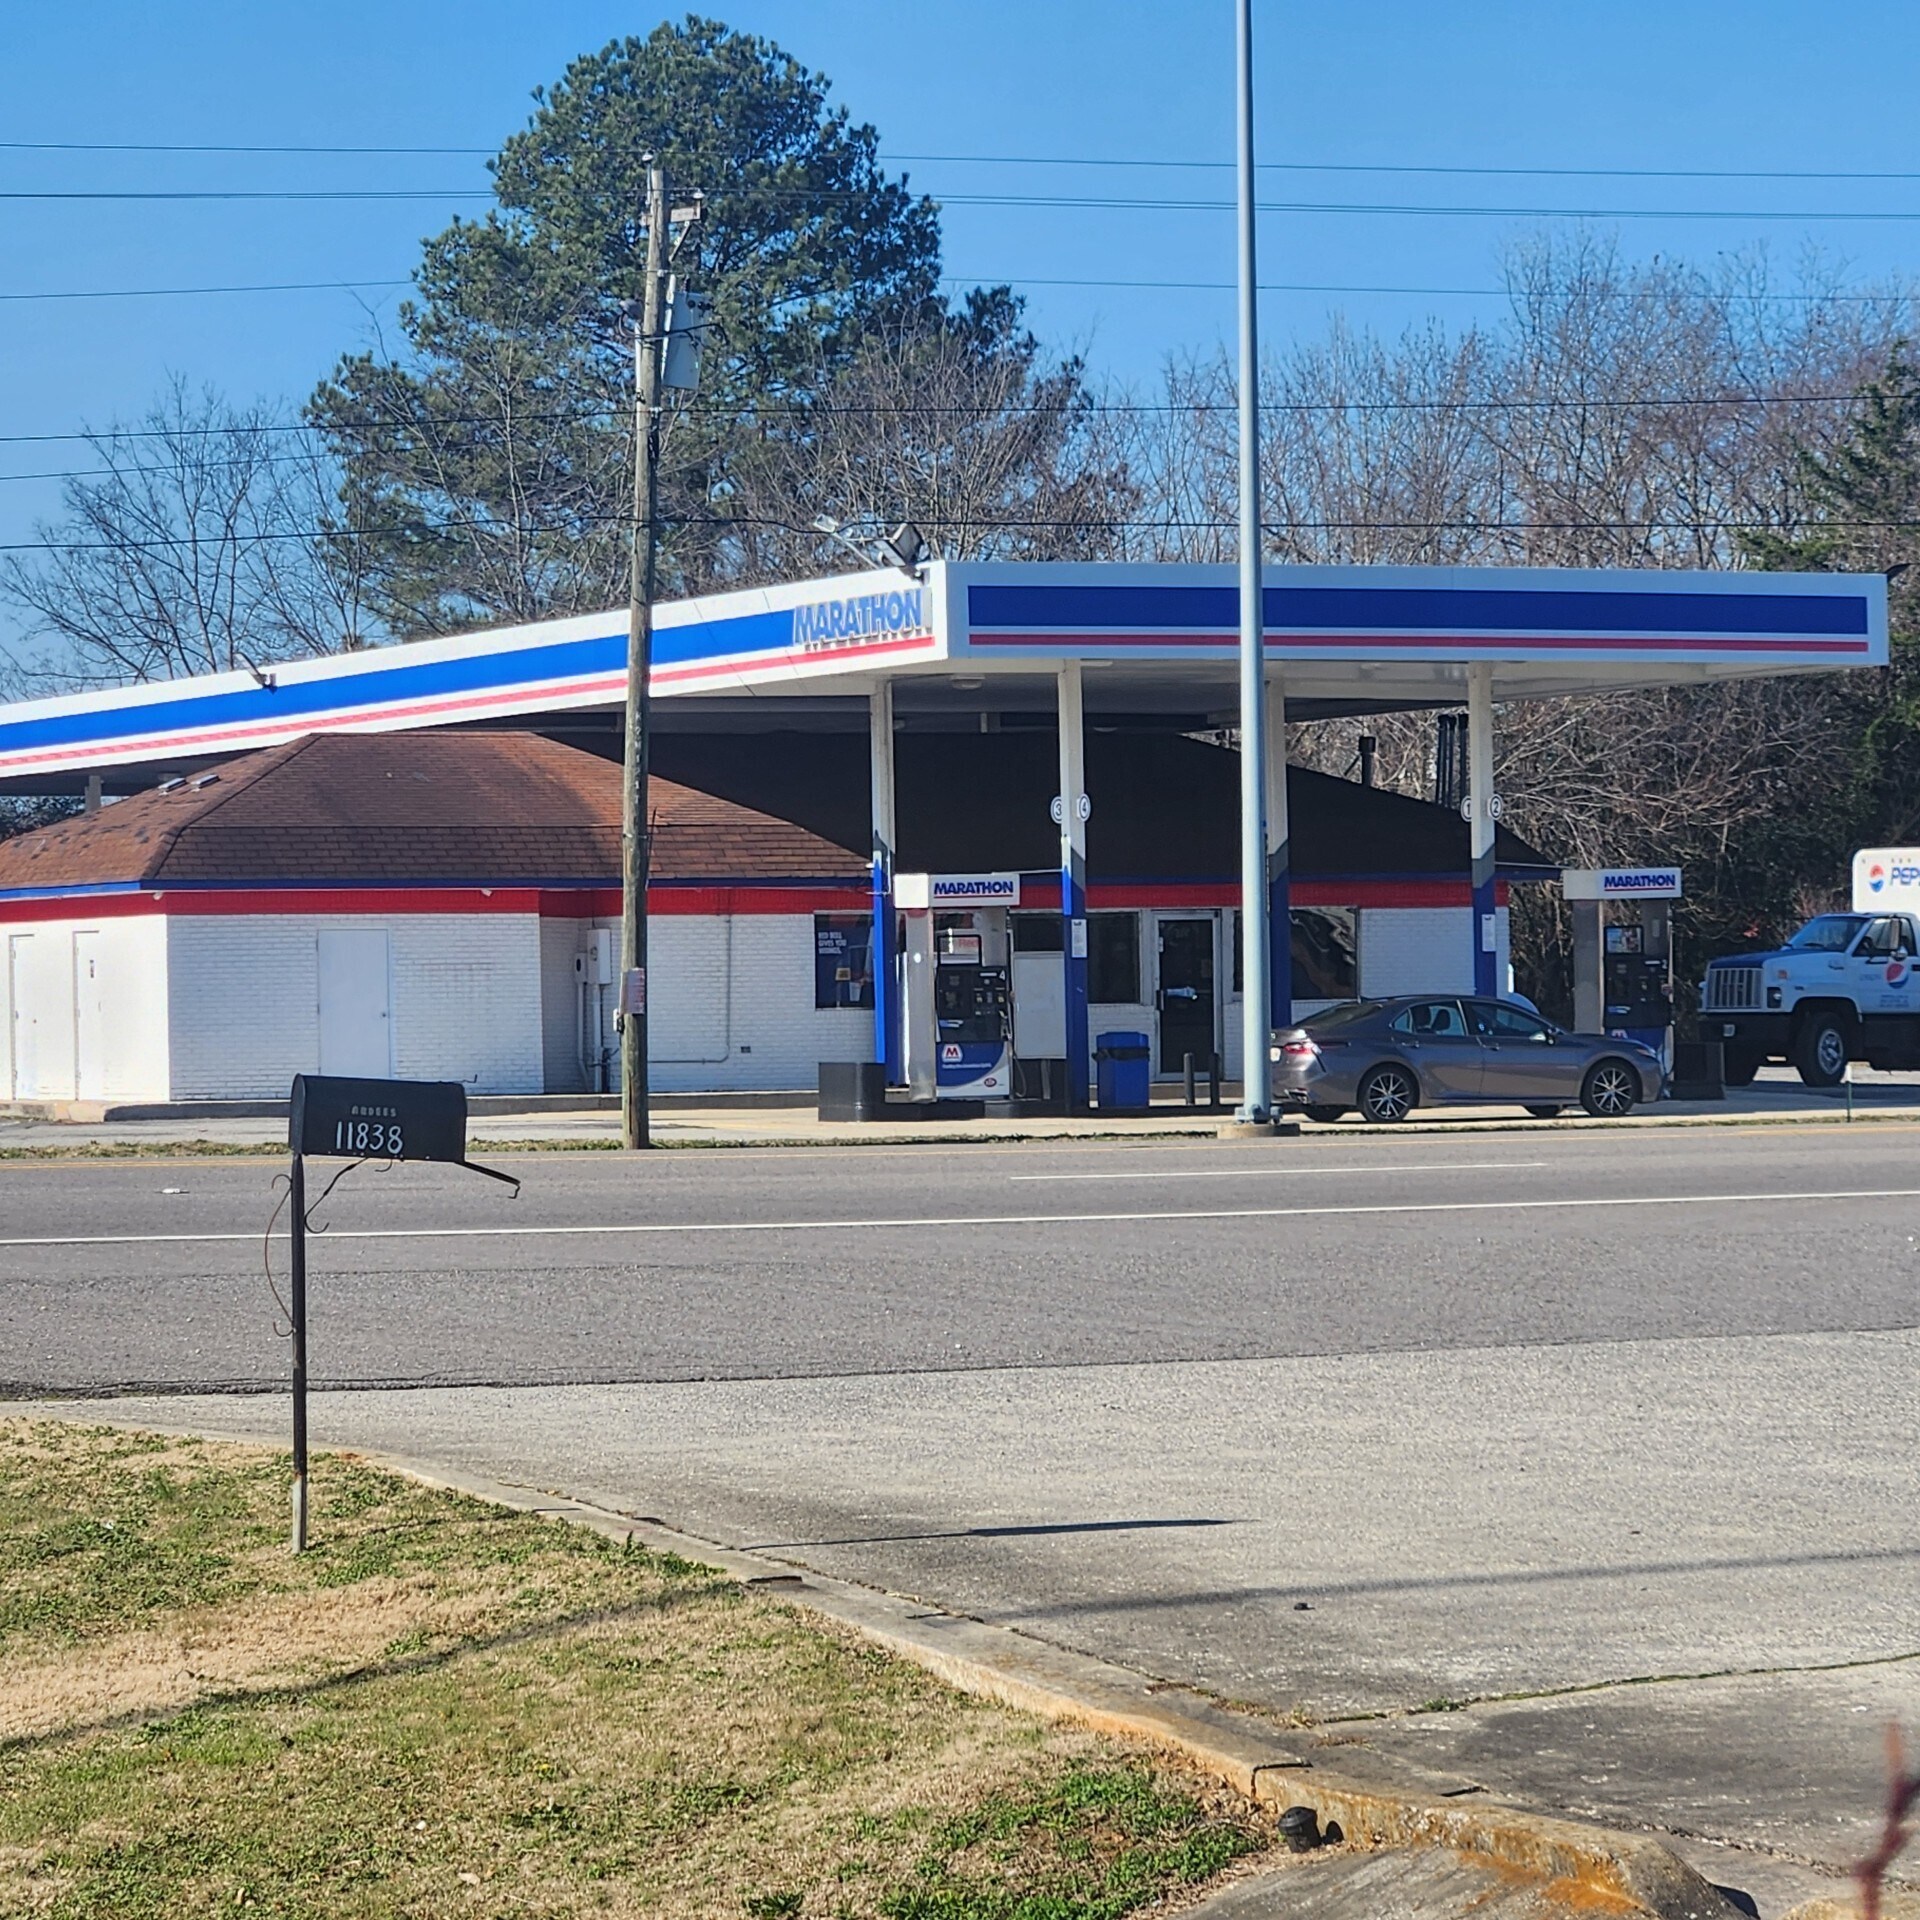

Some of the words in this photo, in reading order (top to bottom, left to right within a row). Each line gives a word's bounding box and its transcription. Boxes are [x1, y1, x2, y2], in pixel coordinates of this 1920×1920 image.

[793, 588, 922, 646] MARATHON
[1604, 874, 1676, 888] MARATHON
[1890, 867, 1920, 885] PEP
[934, 881, 1013, 895] MARATHON
[999, 970, 1006, 980] 4
[945, 1047, 959, 1057] M
[336, 1121, 403, 1154] 11838
